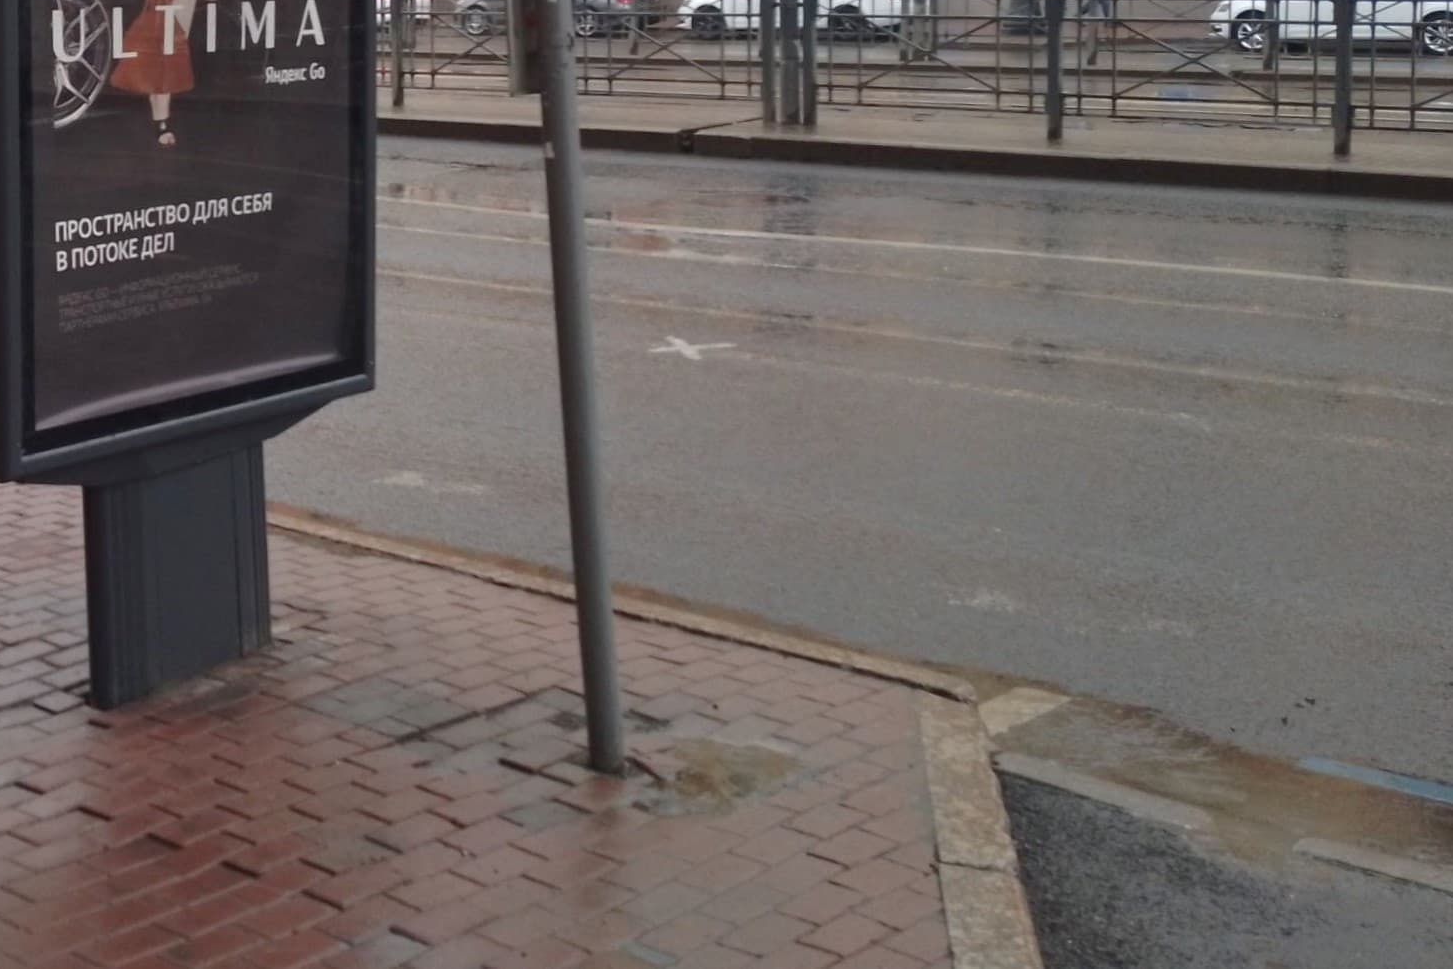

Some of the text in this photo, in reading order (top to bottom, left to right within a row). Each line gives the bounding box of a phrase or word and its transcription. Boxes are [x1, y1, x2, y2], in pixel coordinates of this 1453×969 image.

[264, 62, 325, 84] Яндекс Go
[54, 192, 273, 243] ПРОСТРАНСТВО ДЛЯ СЕБЯ
[56, 231, 175, 272] В ПОТОКЕ ДЕЛ
